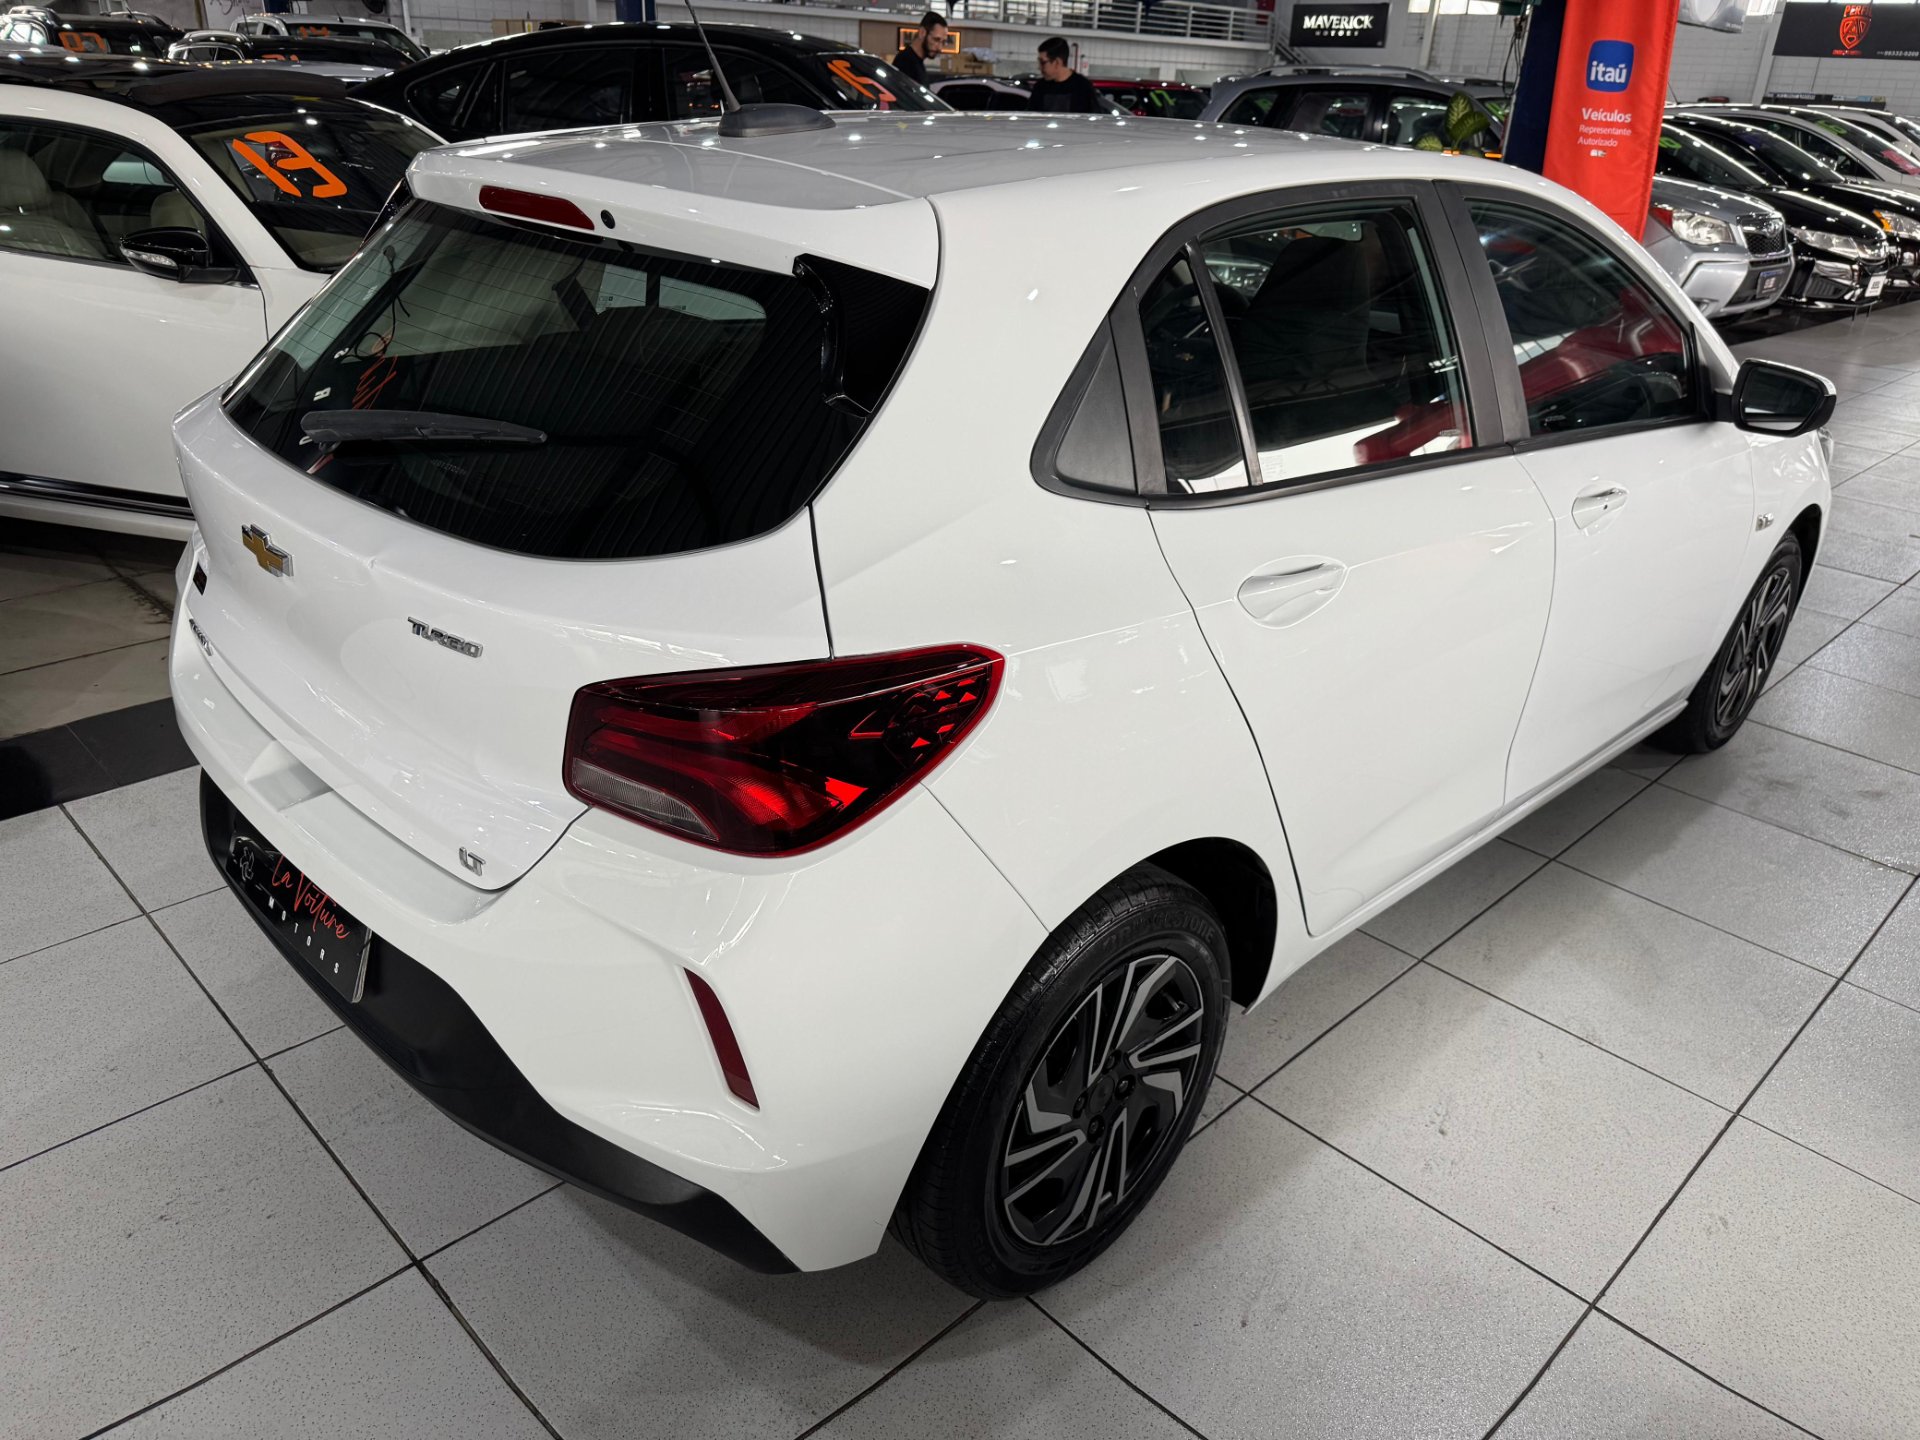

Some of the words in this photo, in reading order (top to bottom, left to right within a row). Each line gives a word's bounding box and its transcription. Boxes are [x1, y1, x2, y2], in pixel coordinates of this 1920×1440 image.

[1302, 15, 1374, 29] MAVERICK
[1590, 60, 1628, 83] itaú
[1582, 107, 1632, 123] Veículos
[1577, 136, 1618, 147] Autorizado
[1579, 124, 1632, 136] Representante
[407, 616, 484, 658] TURBO
[458, 846, 486, 876] LT
[271, 855, 294, 888] La
[293, 871, 351, 940] Voiture
[267, 896, 341, 974] MOTORS
